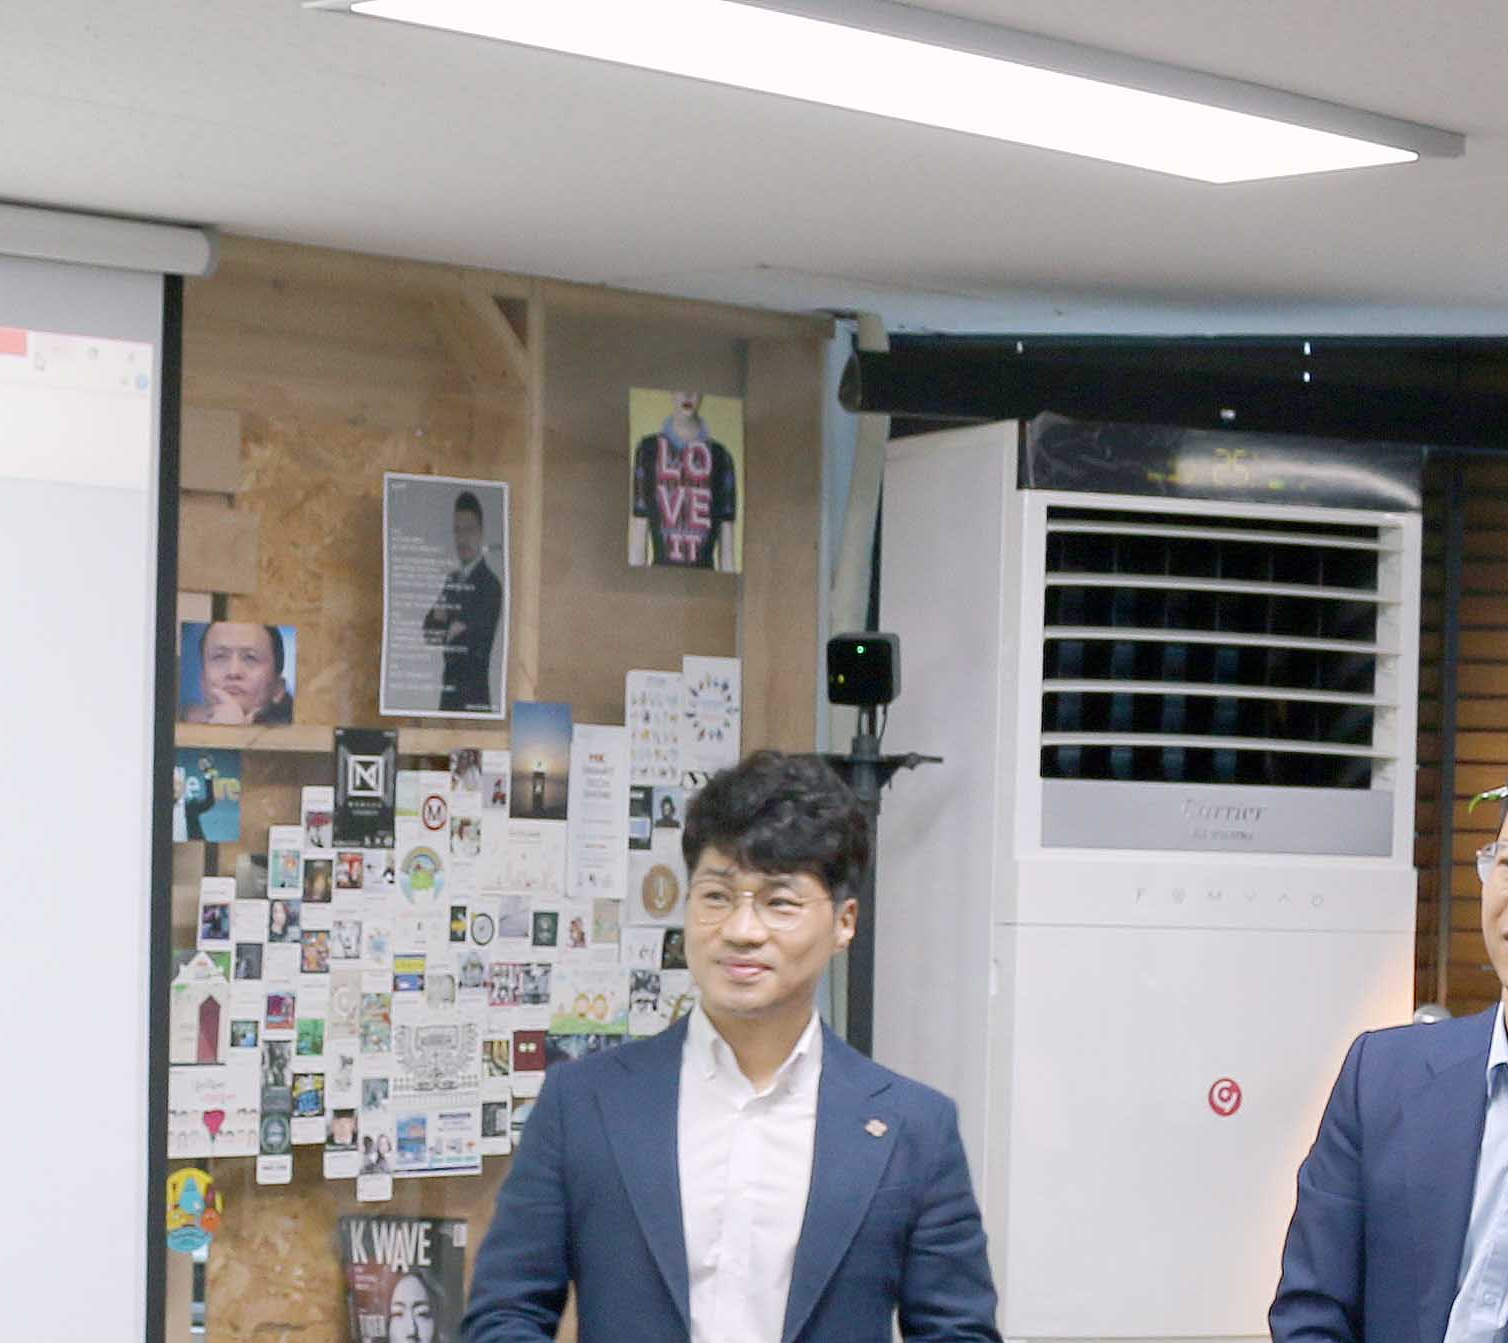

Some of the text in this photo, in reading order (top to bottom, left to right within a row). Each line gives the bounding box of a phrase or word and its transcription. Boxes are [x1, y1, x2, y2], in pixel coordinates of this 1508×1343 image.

[656, 436, 713, 481] LO
[656, 484, 712, 529] VE
[667, 533, 702, 562] IT
[349, 1220, 432, 1273] K WAVE
